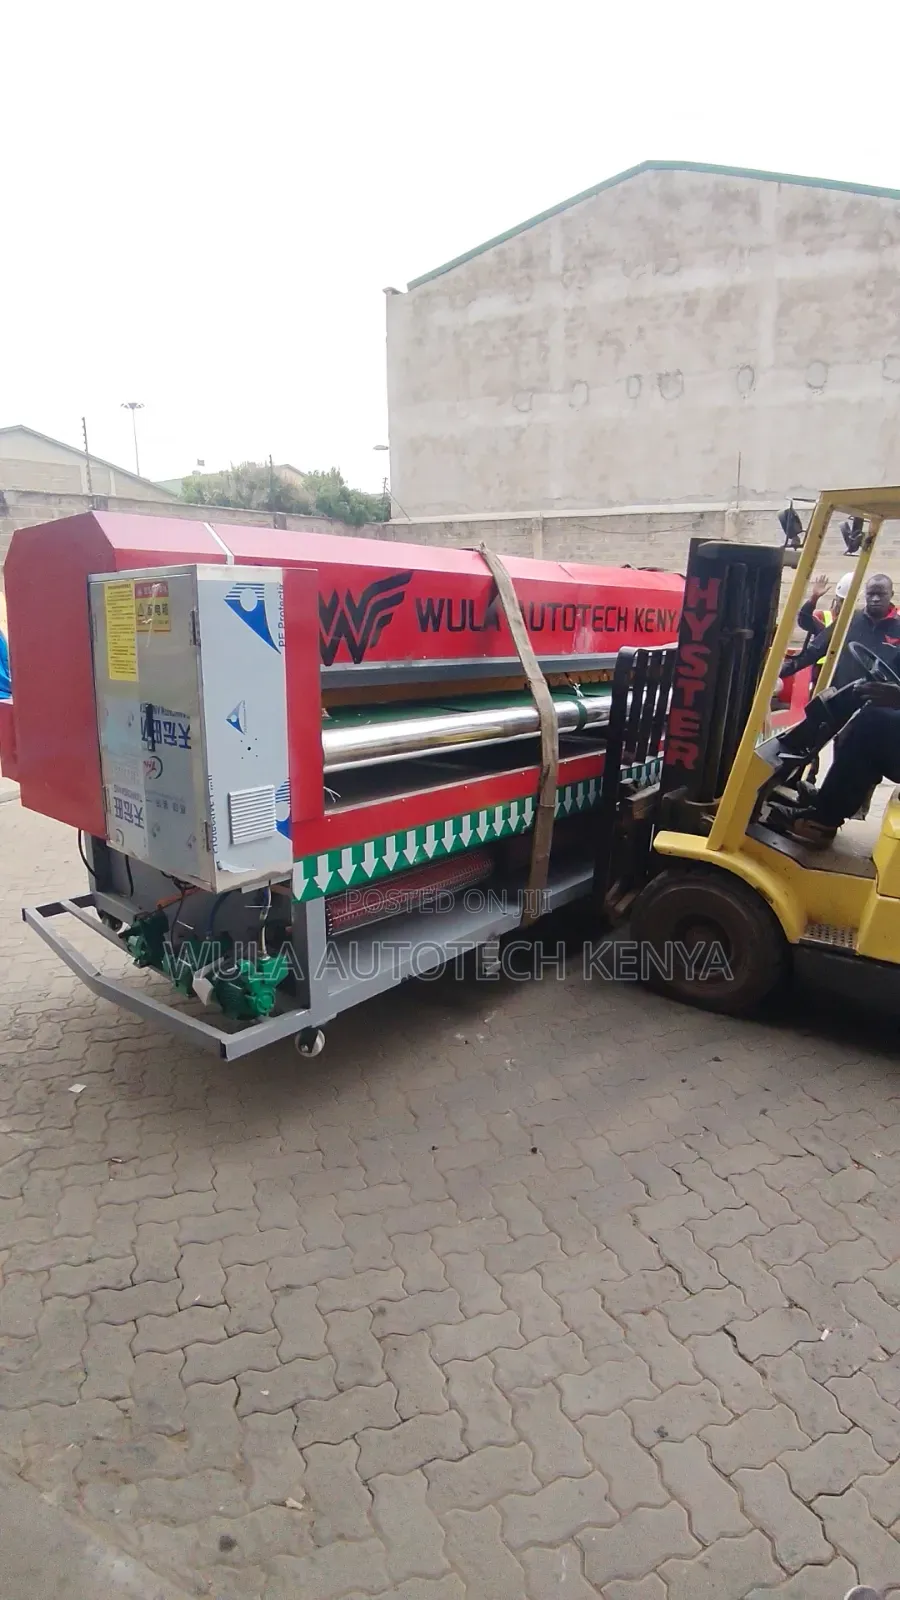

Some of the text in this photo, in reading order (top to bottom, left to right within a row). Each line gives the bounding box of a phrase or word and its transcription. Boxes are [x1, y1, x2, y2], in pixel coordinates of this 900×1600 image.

[415, 597, 681, 633] WULA UTOTECH KENY
[666, 577, 721, 771] HYSTER
